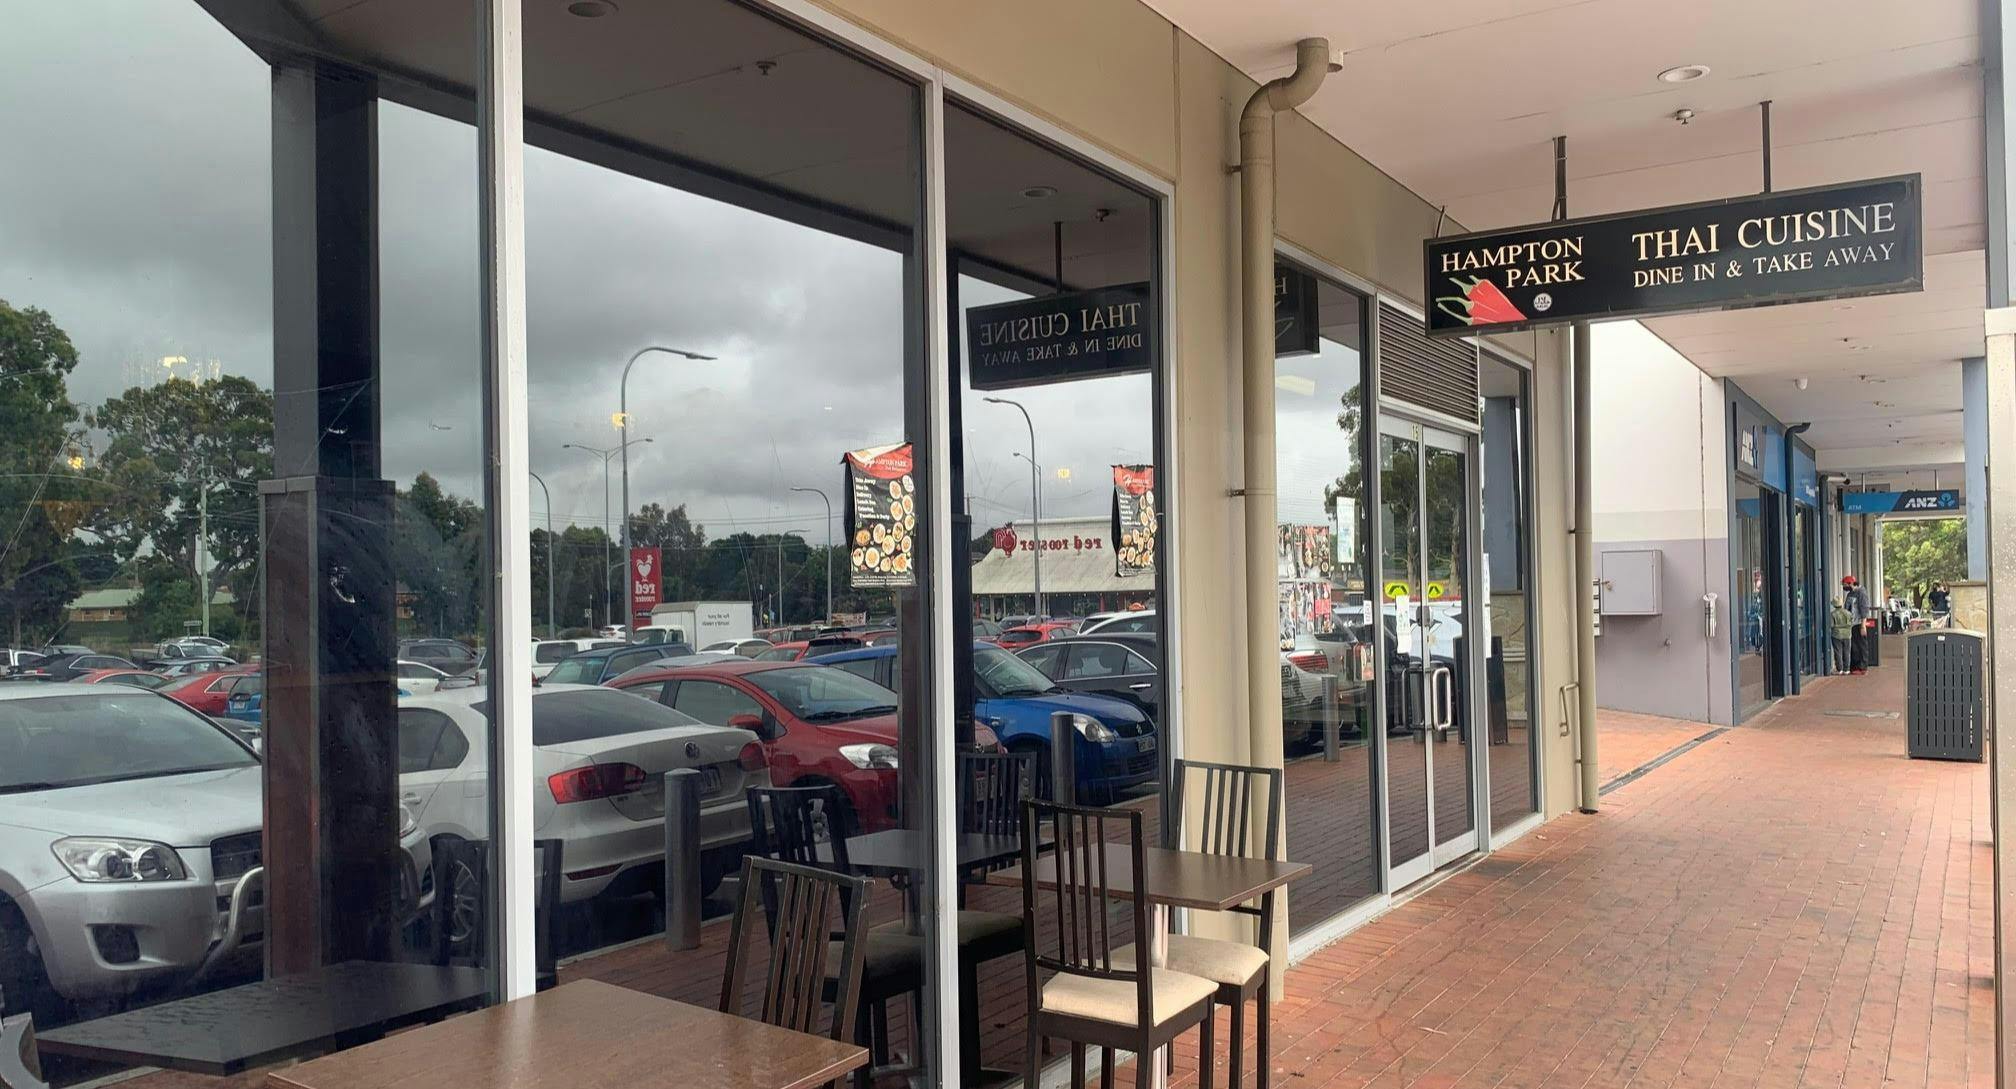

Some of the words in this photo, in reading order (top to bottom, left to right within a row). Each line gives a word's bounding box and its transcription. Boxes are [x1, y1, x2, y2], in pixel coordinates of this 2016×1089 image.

[1631, 223, 1719, 261] THAI
[1737, 201, 1896, 249] CUISINE
[1441, 236, 1584, 273] HAMPTON
[1633, 266, 1684, 289] DINE
[1693, 262, 1716, 283] IN
[1726, 259, 1743, 279] &
[1752, 251, 1814, 276] TAKE
[1823, 241, 1895, 268] AWAY
[1505, 259, 1586, 290] PARK
[1905, 497, 1938, 508] ANZ
